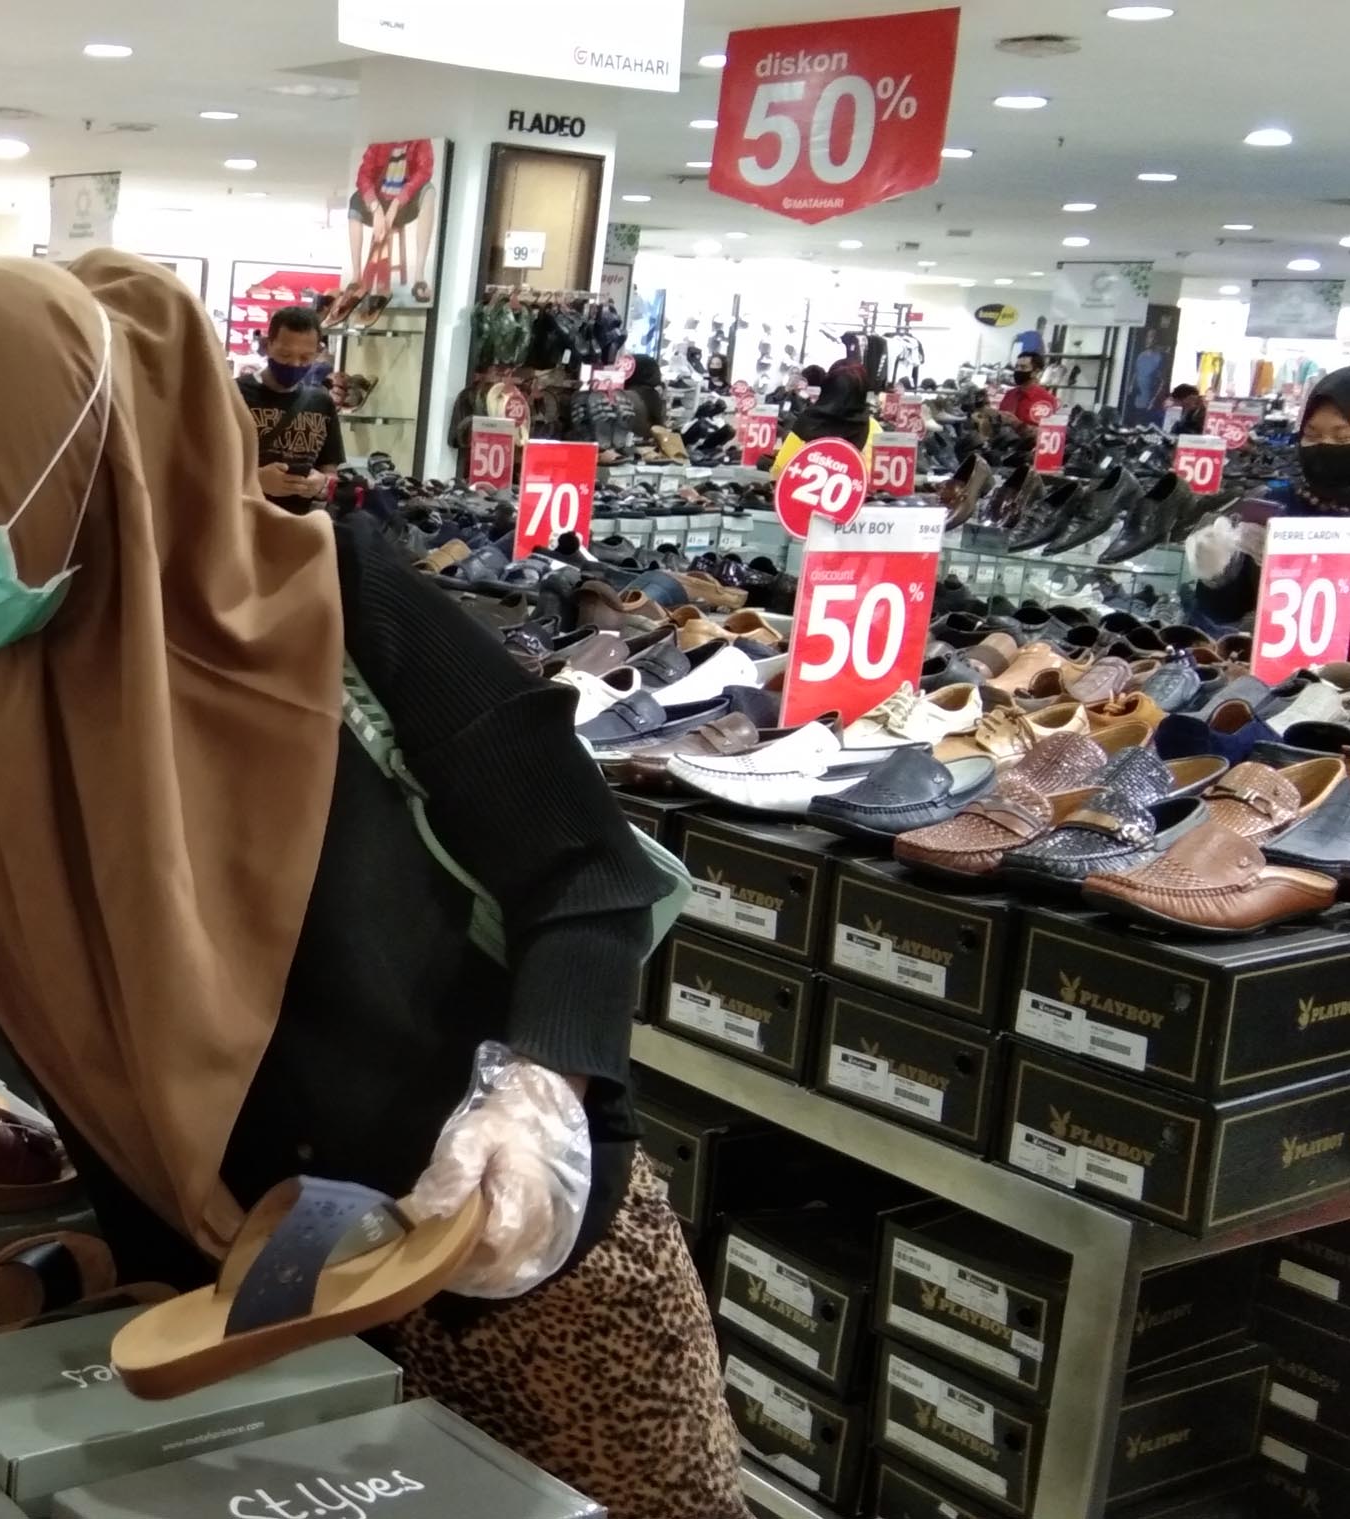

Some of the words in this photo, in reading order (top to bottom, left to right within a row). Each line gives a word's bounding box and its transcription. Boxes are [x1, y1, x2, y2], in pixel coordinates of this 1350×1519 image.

[590, 51, 670, 77] MATAHARI
[755, 50, 848, 77] diskon
[507, 109, 586, 138] FLADEO
[792, 197, 845, 209] MATAHARI
[513, 246, 529, 261] 99
[806, 451, 849, 475] diskon
[868, 522, 895, 535] BOY
[1273, 531, 1306, 541] PIERRE
[1308, 530, 1341, 542] CARDIN
[1080, 989, 1165, 1030] PLAYBOY
[1068, 1123, 1155, 1167] PLAYBOY
[1294, 1131, 1345, 1160] PLAYBOY
[761, 1291, 819, 1334] PLAYBOY
[937, 1297, 1012, 1341] PLAYBOY
[932, 1417, 1000, 1462] PLAYBOY
[229, 1469, 426, 1519] St.Yves
